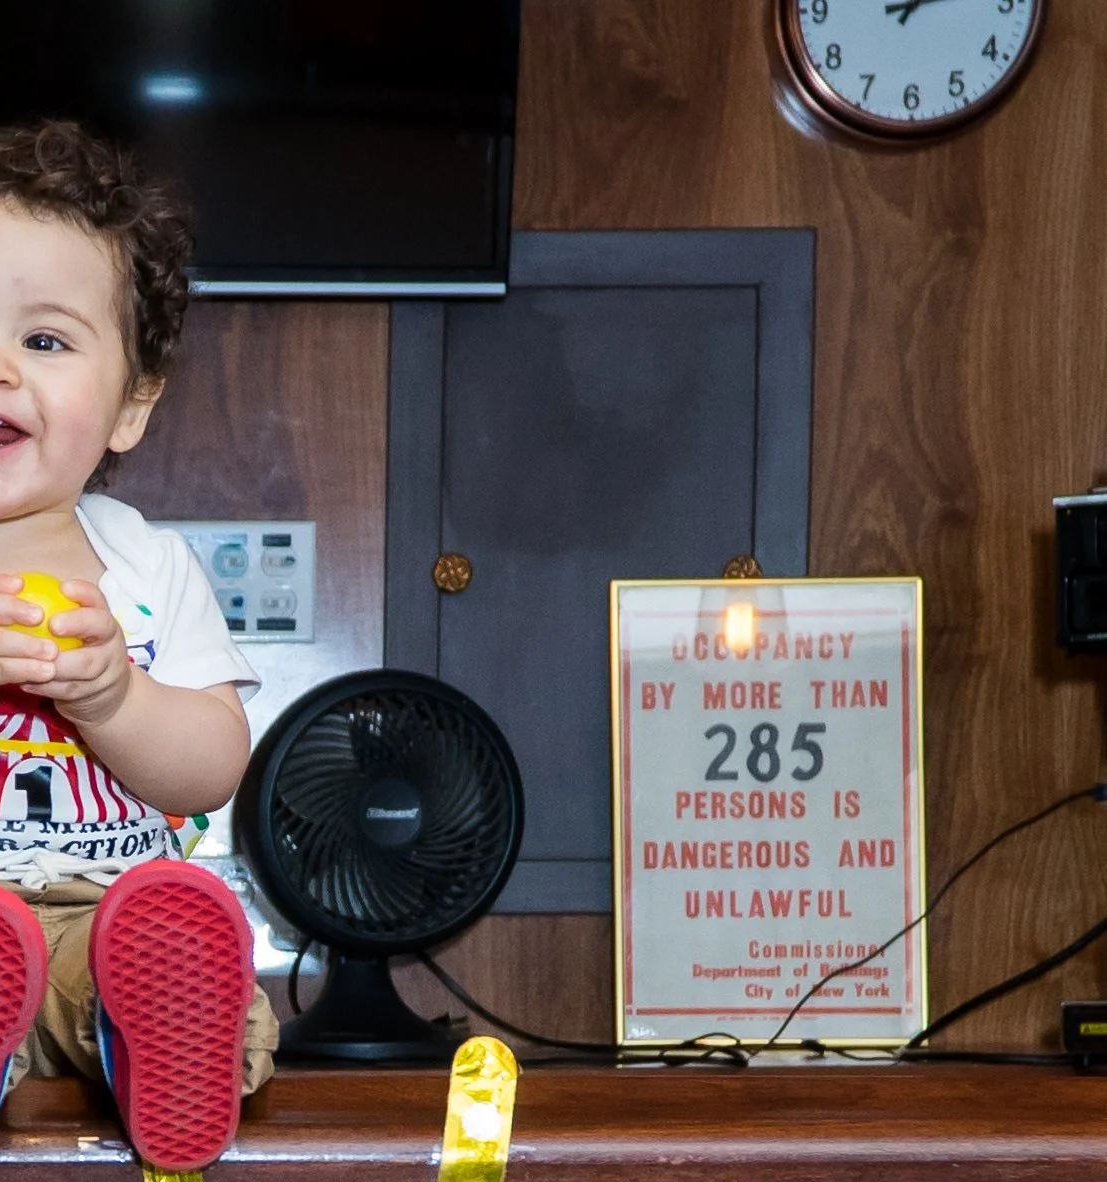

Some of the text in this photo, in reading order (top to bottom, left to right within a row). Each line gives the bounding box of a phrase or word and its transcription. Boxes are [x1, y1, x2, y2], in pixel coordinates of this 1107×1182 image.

[811, 0, 828, 23] 9
[825, 43, 842, 70] 8
[981, 34, 998, 61] 4
[859, 73, 876, 100] 7
[903, 84, 920, 110] 6
[948, 70, 965, 97] 5
[641, 679, 889, 711] BY MORE THAN
[703, 722, 827, 783] 285
[15, 766, 53, 822] 1
[675, 790, 862, 820] PERSONS IS
[643, 838, 897, 870] DANGEROUS AND
[684, 889, 853, 919] UNLAWFUL
[749, 940, 885, 959] Commissioner
[692, 963, 781, 981] Department
[793, 963, 808, 977] of
[745, 983, 890, 1000] City of New York
